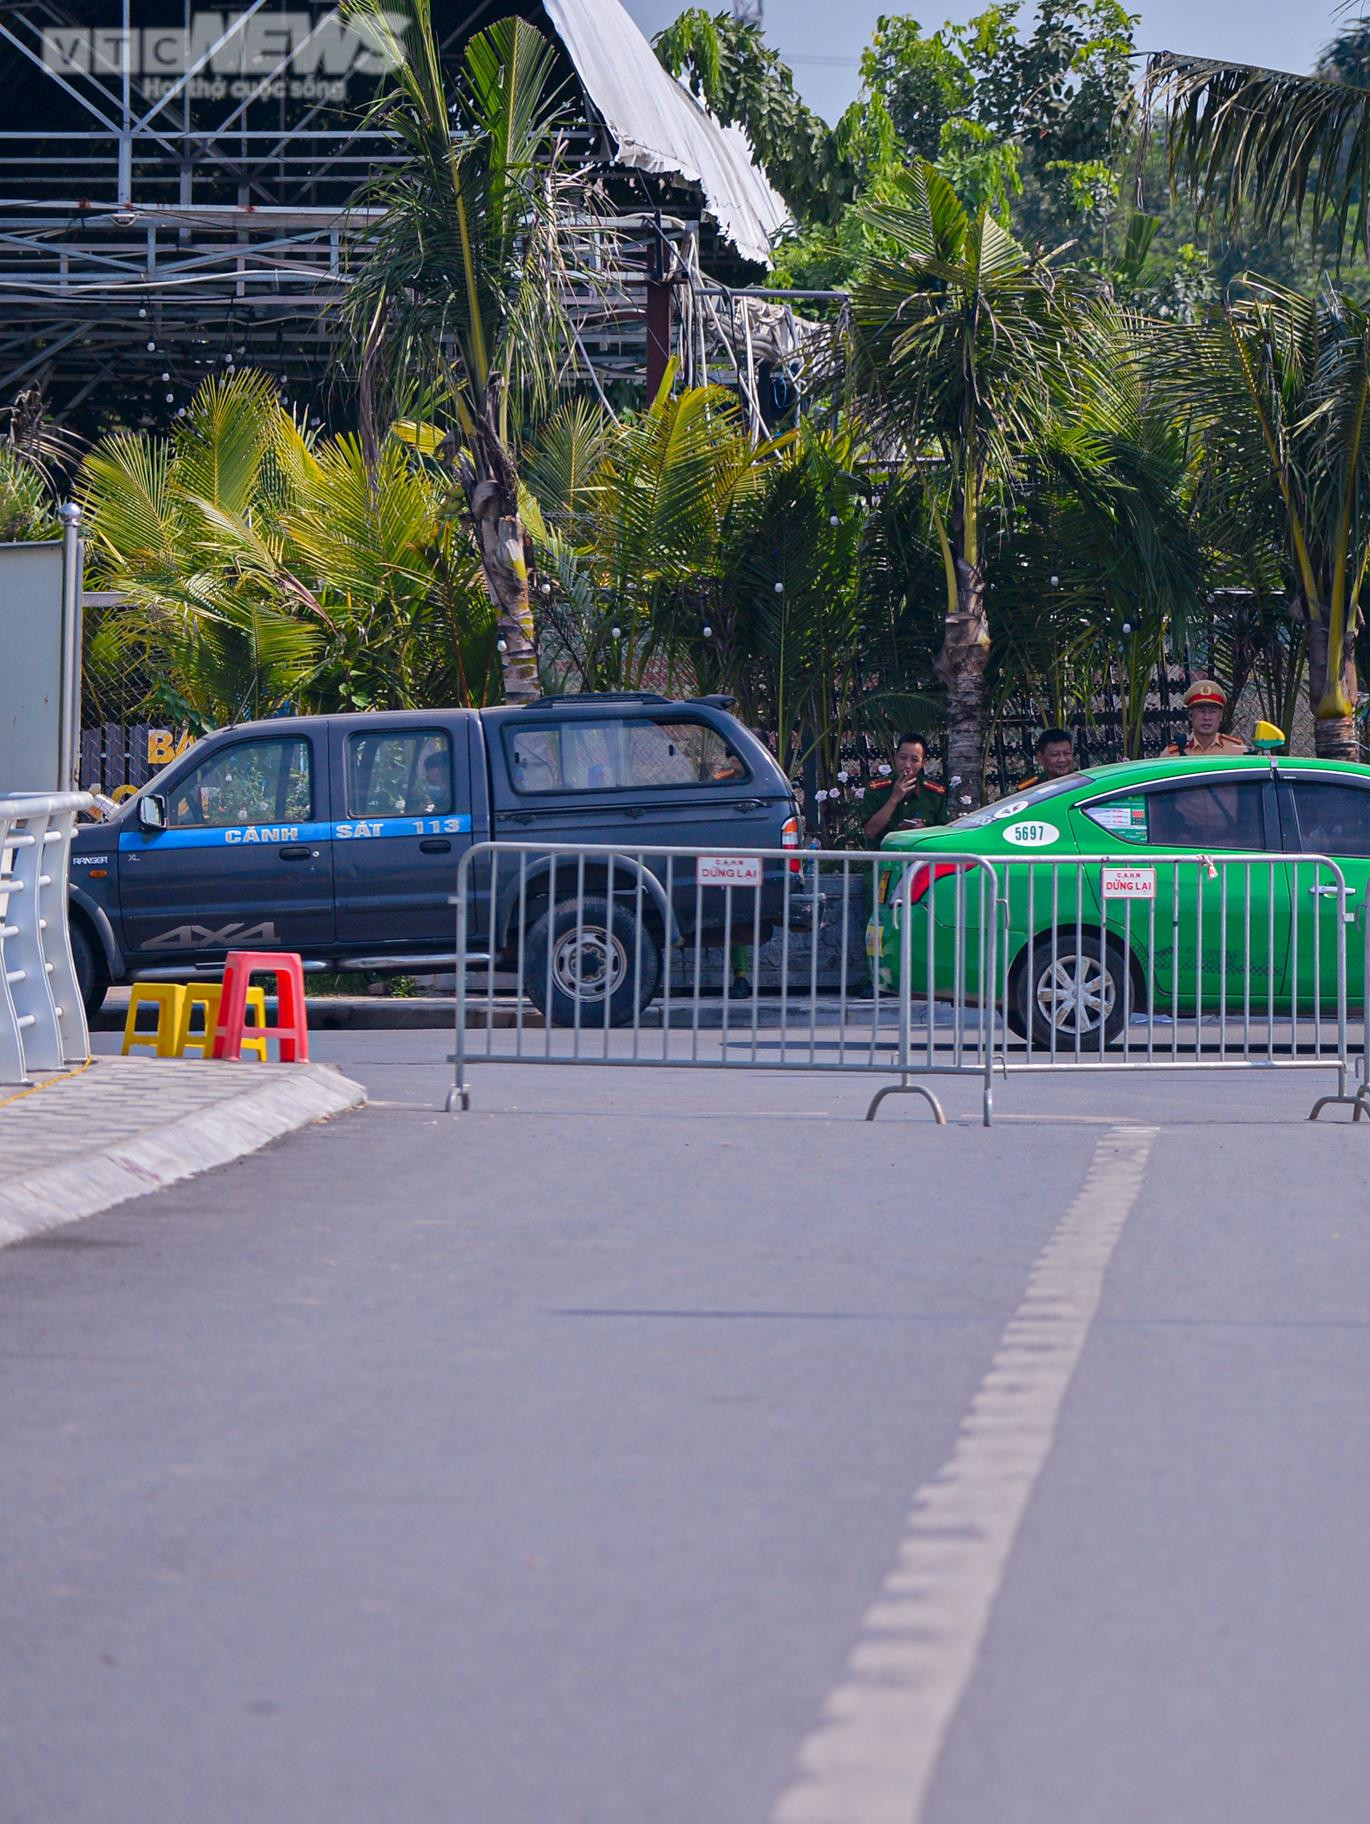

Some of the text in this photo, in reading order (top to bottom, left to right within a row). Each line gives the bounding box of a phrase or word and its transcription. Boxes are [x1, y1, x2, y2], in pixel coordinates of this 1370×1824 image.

[225, 819, 461, 844] CẢNH SÁT 113
[1015, 825, 1044, 841] 5697
[73, 856, 108, 865] RANGER
[702, 866, 756, 879] DỪNG LẠI
[1106, 879, 1152, 893] DỪNG LẠI
